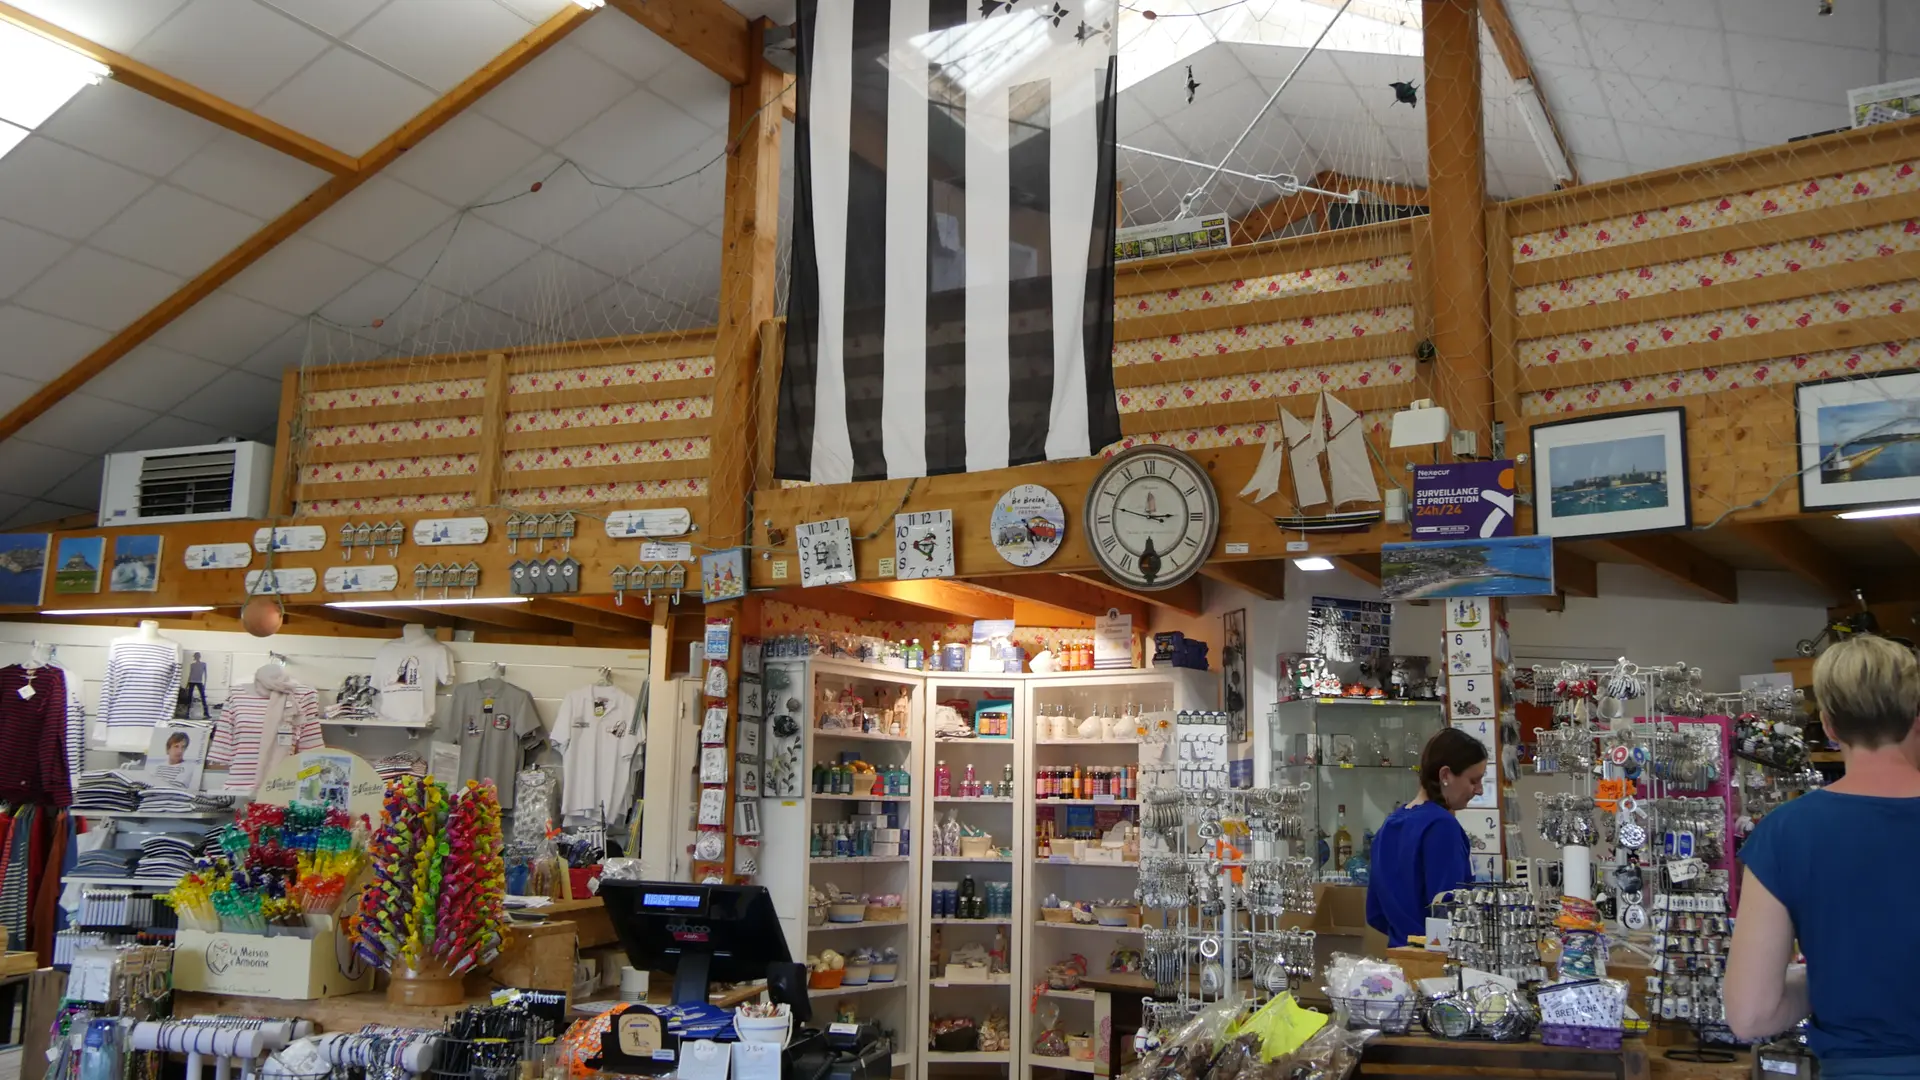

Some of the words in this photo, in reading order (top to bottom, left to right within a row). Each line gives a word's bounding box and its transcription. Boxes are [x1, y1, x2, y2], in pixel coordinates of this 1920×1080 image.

[1417, 487, 1479, 498] SURVEILLANCE
[1428, 495, 1479, 505] PROTECTION
[1416, 504, 1463, 516] 24h/24
[908, 514, 915, 526] 11
[921, 513, 931, 525] 12
[938, 511, 942, 523] 1
[1190, 513, 1203, 521] III
[808, 524, 815, 535] 11
[820, 521, 830, 533] 12
[836, 520, 840, 530] 1
[945, 520, 950, 532] 2
[844, 528, 849, 540] 2
[896, 526, 908, 538] 10
[799, 536, 809, 548] 10
[899, 542, 907, 554] 9
[946, 536, 951, 549] 3
[846, 543, 851, 556] 3
[802, 551, 809, 563] 9
[899, 557, 906, 569] 8
[946, 552, 952, 565] 4
[848, 560, 853, 571] 4
[935, 565, 945, 577] 5
[803, 567, 811, 579] 8
[907, 567, 916, 577] 7
[921, 568, 929, 577] 6
[1455, 633, 1463, 646] 6
[1467, 680, 1475, 691] 5
[1479, 722, 1486, 734] 4
[1485, 817, 1496, 829] 2
[229, 947, 238, 956] La
[240, 947, 269, 956] Maison
[1555, 1005, 1598, 1018] BRETAGNE
